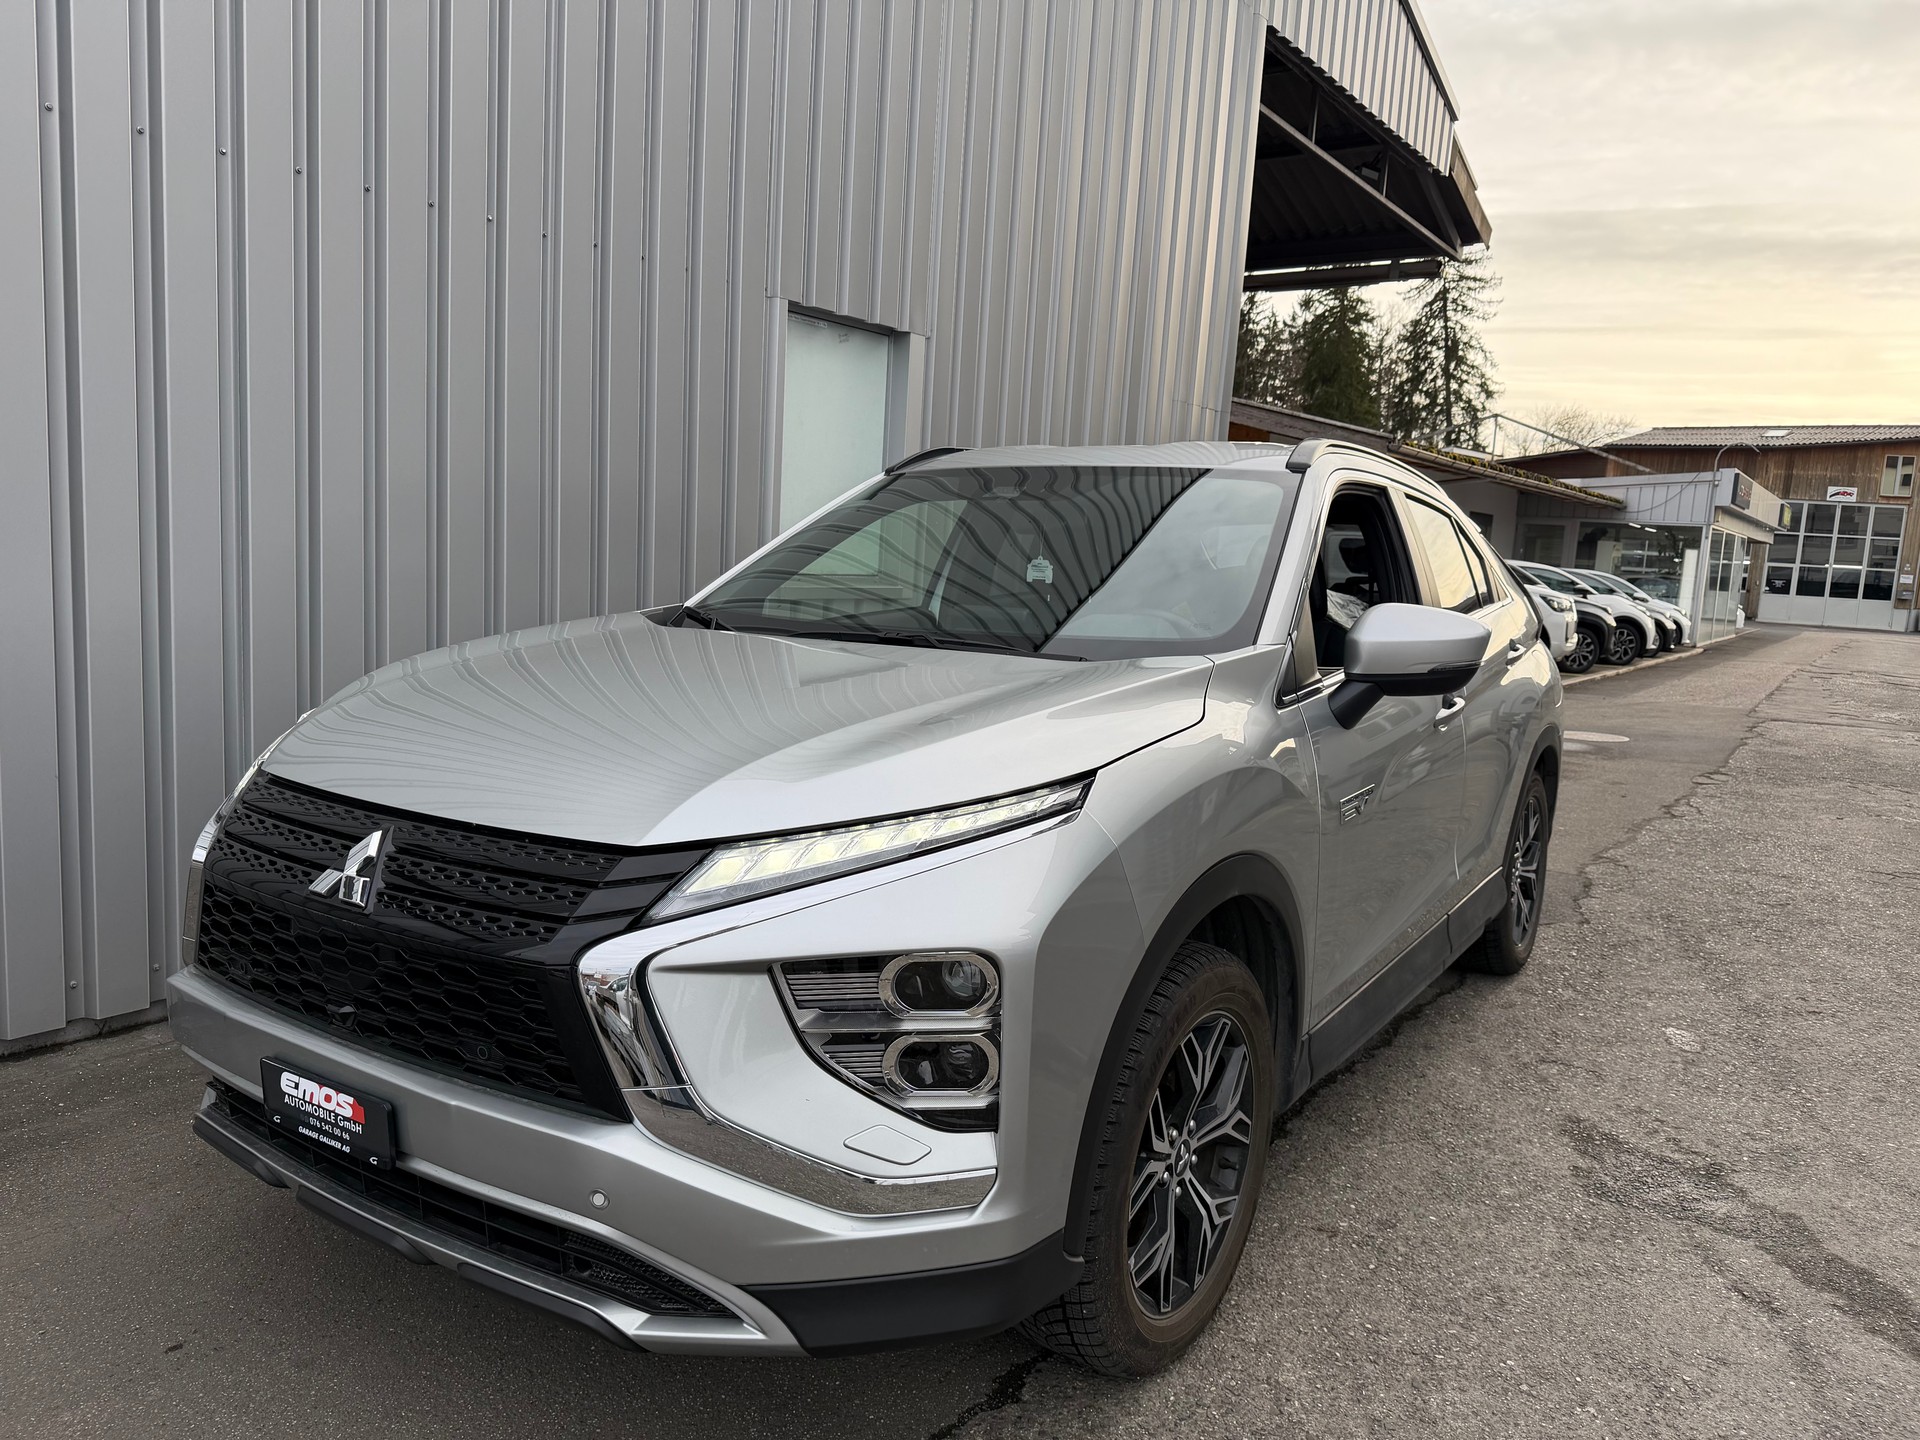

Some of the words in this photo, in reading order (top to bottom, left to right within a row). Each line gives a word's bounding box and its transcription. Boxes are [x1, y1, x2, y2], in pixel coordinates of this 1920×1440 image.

[284, 1094, 335, 1123] AUTOMOBILE
[337, 1115, 362, 1134] GmbH
[309, 1117, 321, 1128] 076
[322, 1122, 333, 1133] 542
[333, 1127, 341, 1137] 00
[298, 1125, 319, 1139] GARAGE
[342, 1144, 350, 1153] AG
